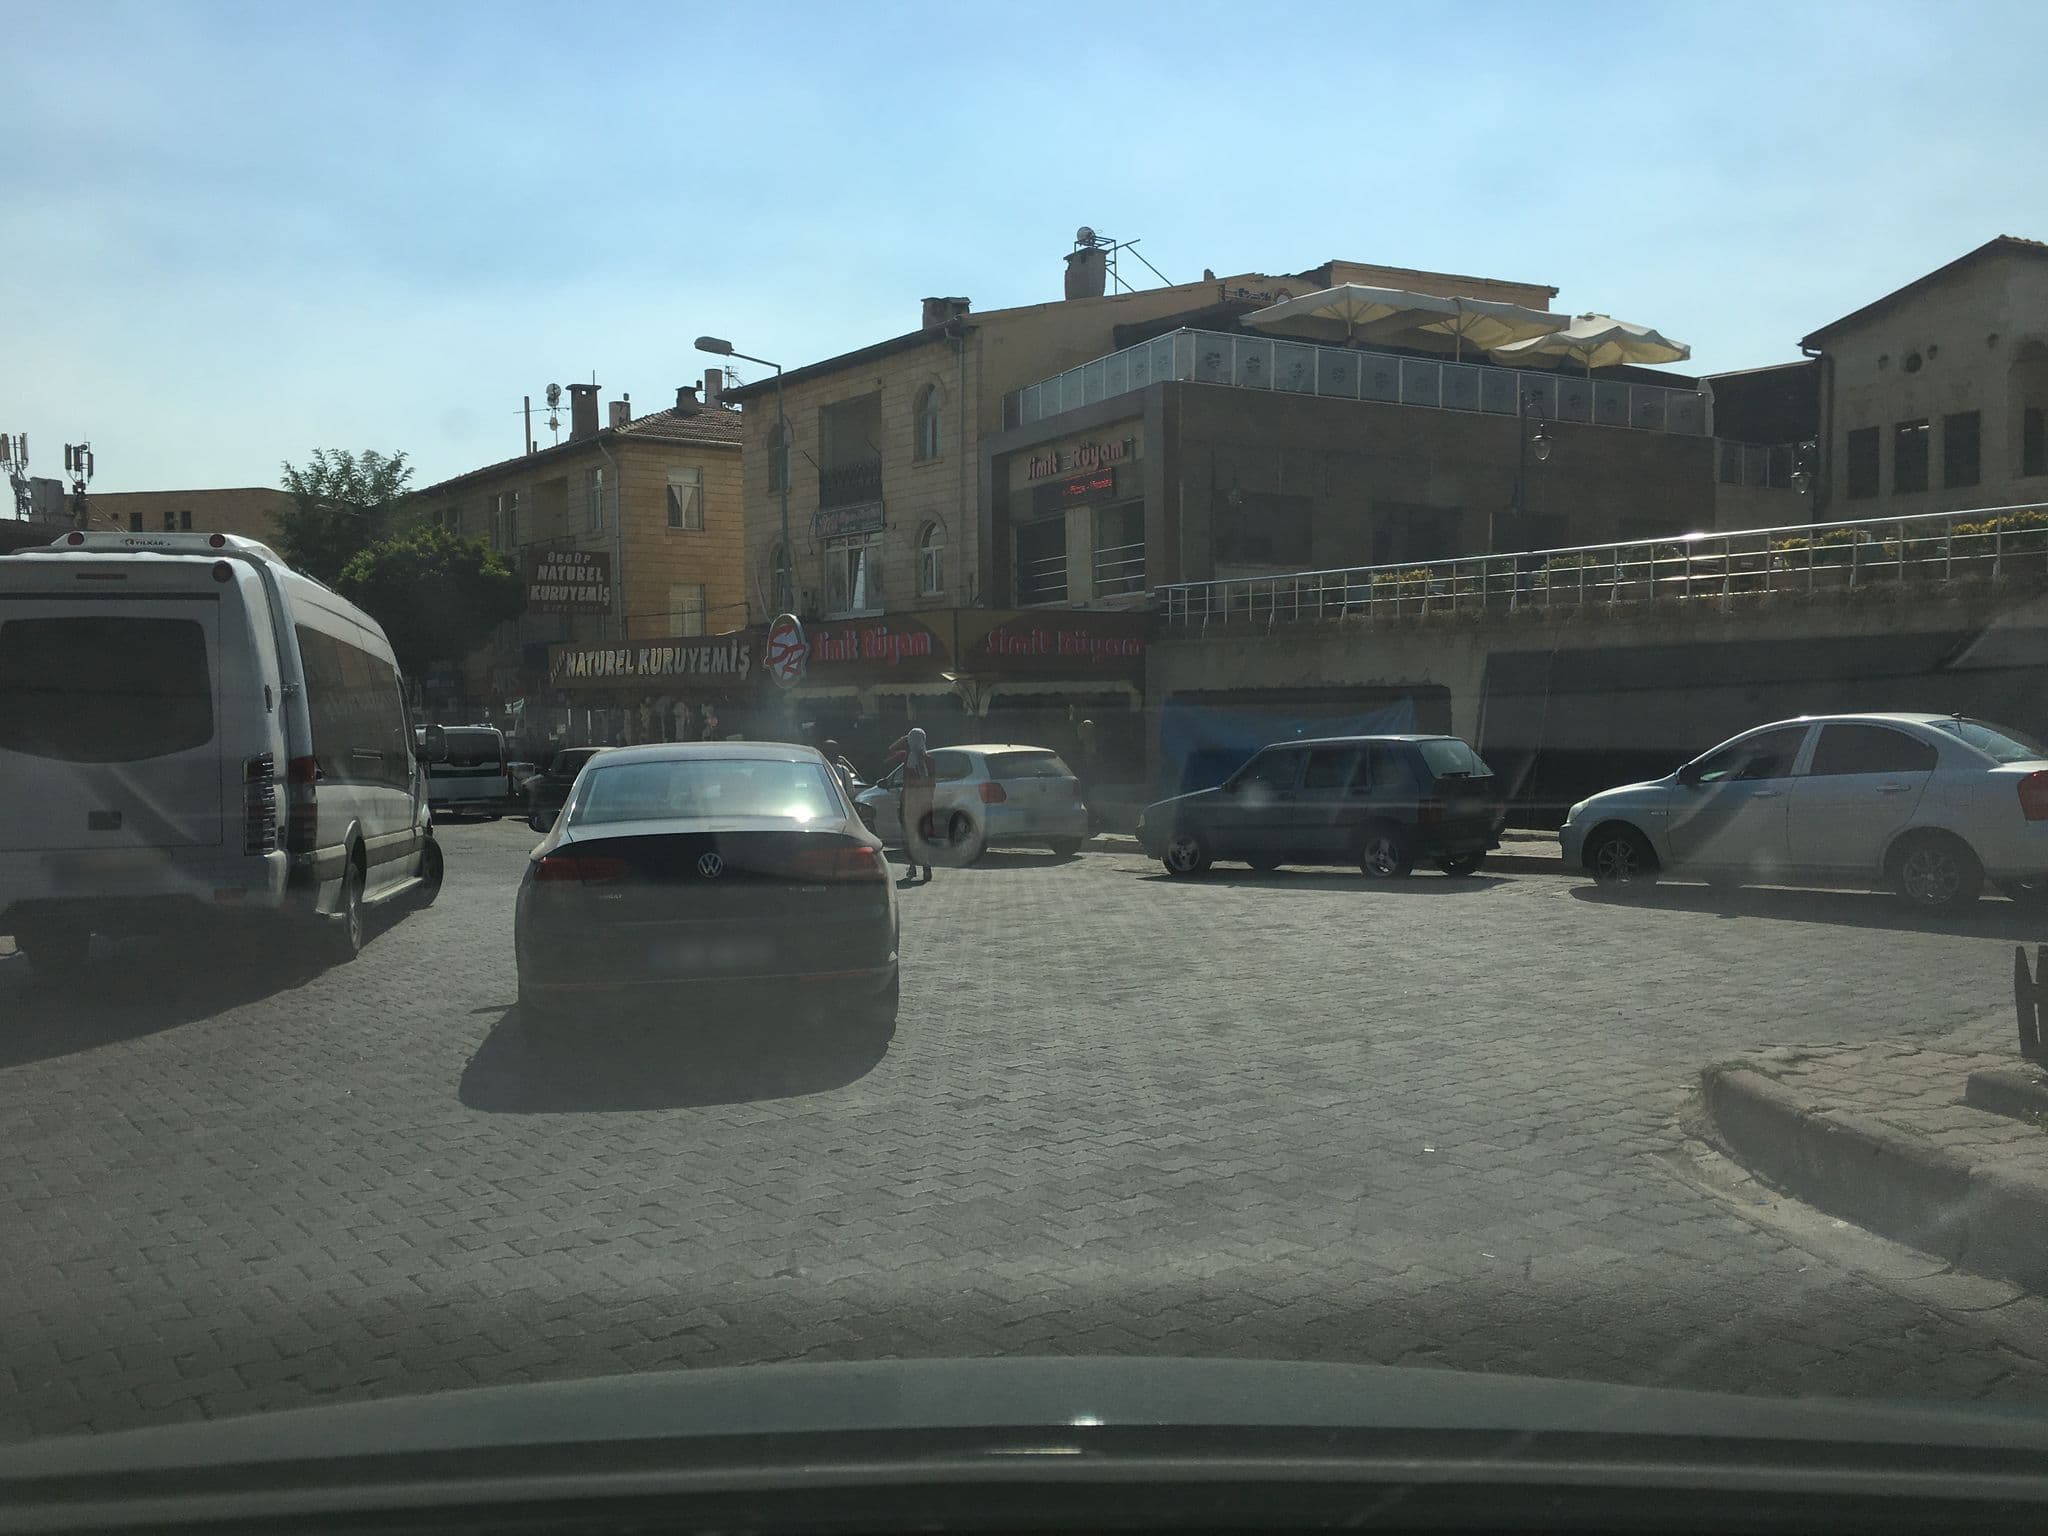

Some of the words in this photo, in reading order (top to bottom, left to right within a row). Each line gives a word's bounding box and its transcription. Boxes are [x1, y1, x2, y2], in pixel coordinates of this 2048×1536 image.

[537, 564, 604, 582] NATUREL
[529, 583, 611, 606] KURUYEMİŞ
[565, 648, 635, 678] NATUREL
[637, 639, 751, 681] KURUYEMİŞ
